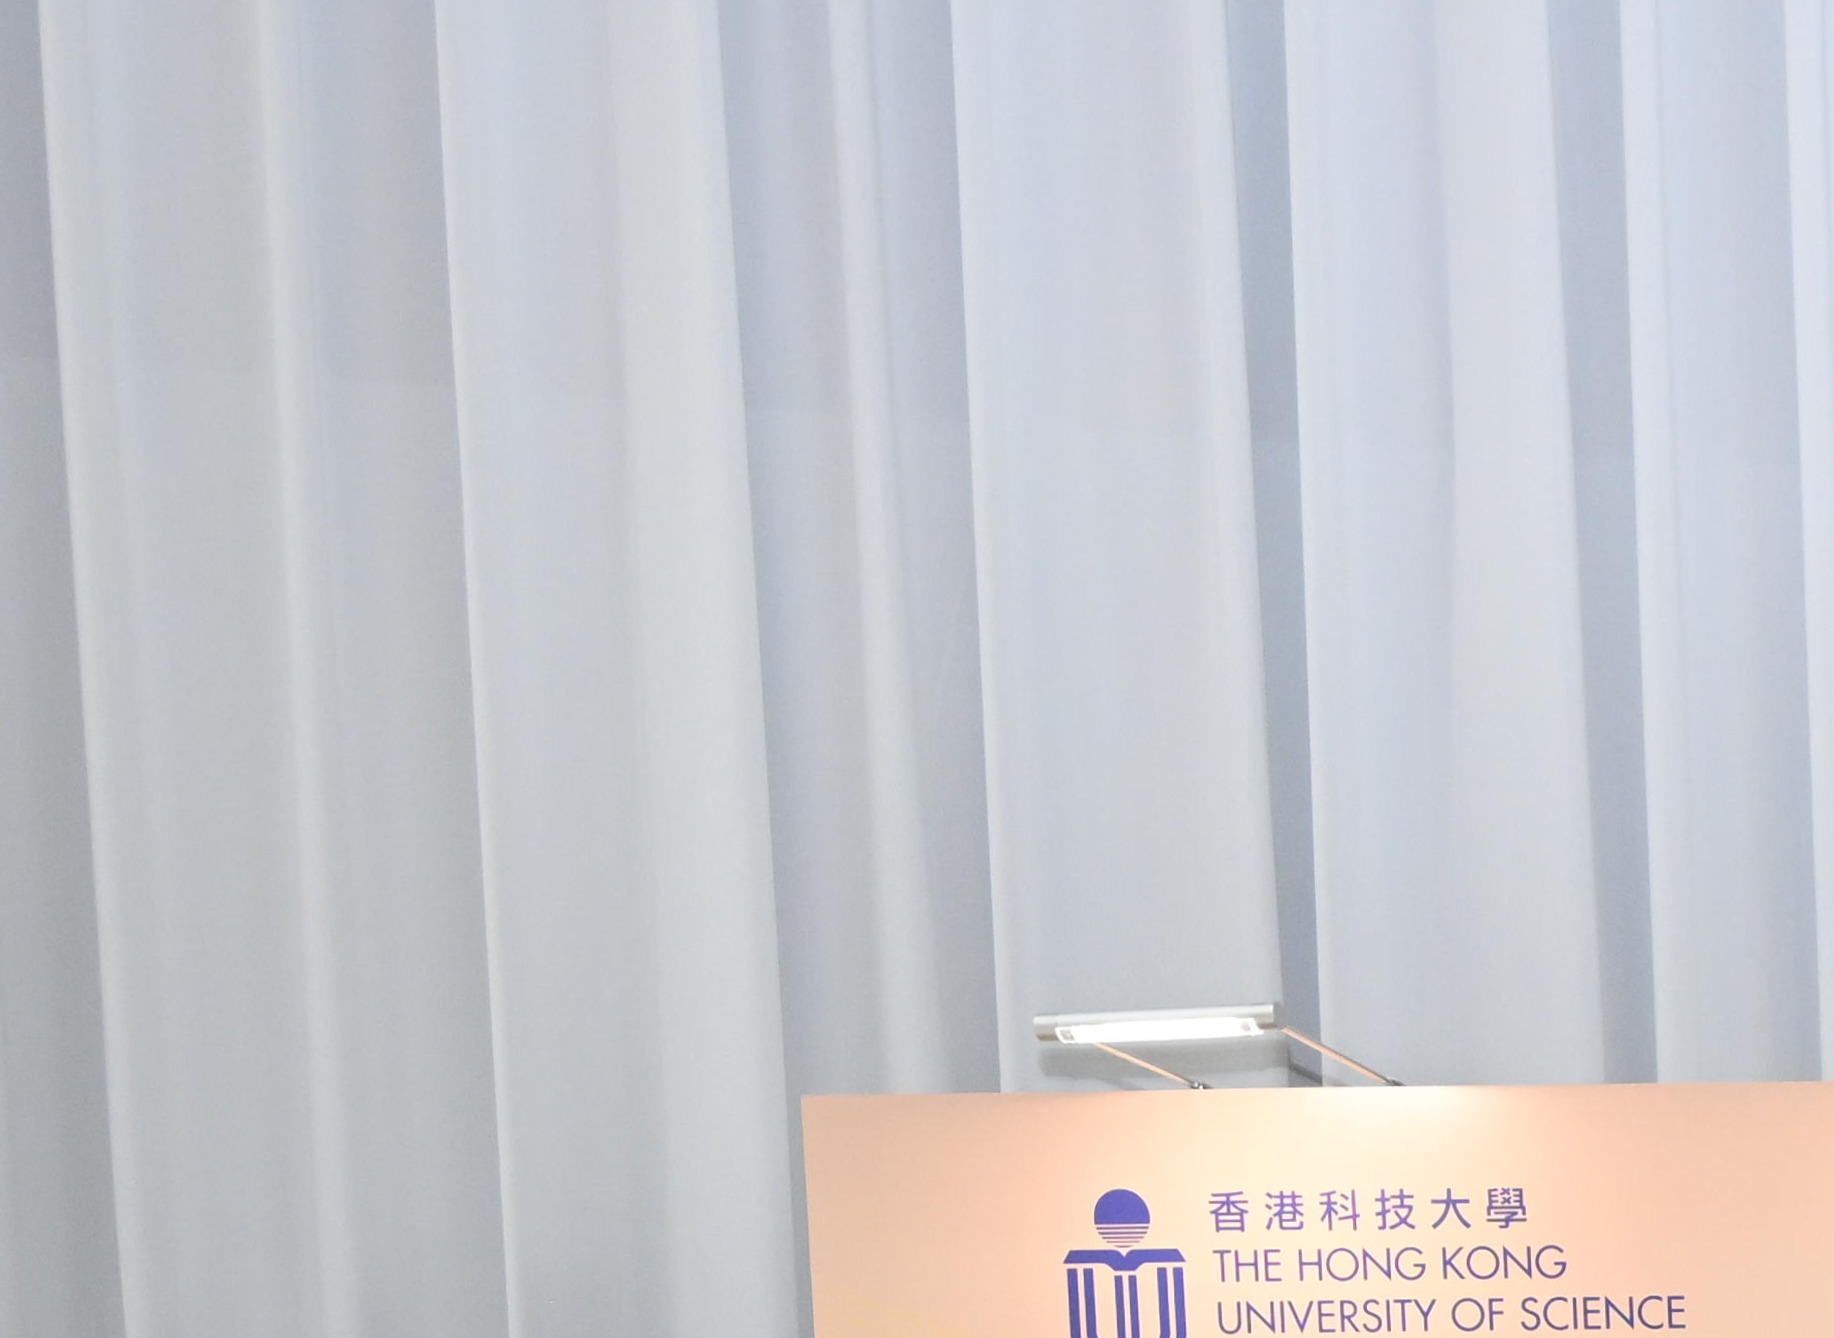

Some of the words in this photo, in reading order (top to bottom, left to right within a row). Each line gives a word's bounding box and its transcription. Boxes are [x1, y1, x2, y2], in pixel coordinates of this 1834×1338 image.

[1208, 1187, 1528, 1233] 香港科技大學
[1213, 1247, 1282, 1283] THE
[1297, 1246, 1426, 1283] HONG
[1441, 1244, 1568, 1281] KONG
[1216, 1298, 1436, 1335] UNIVERSITY
[1451, 1296, 1505, 1333] OF
[1520, 1295, 1688, 1332] SCIENCE
